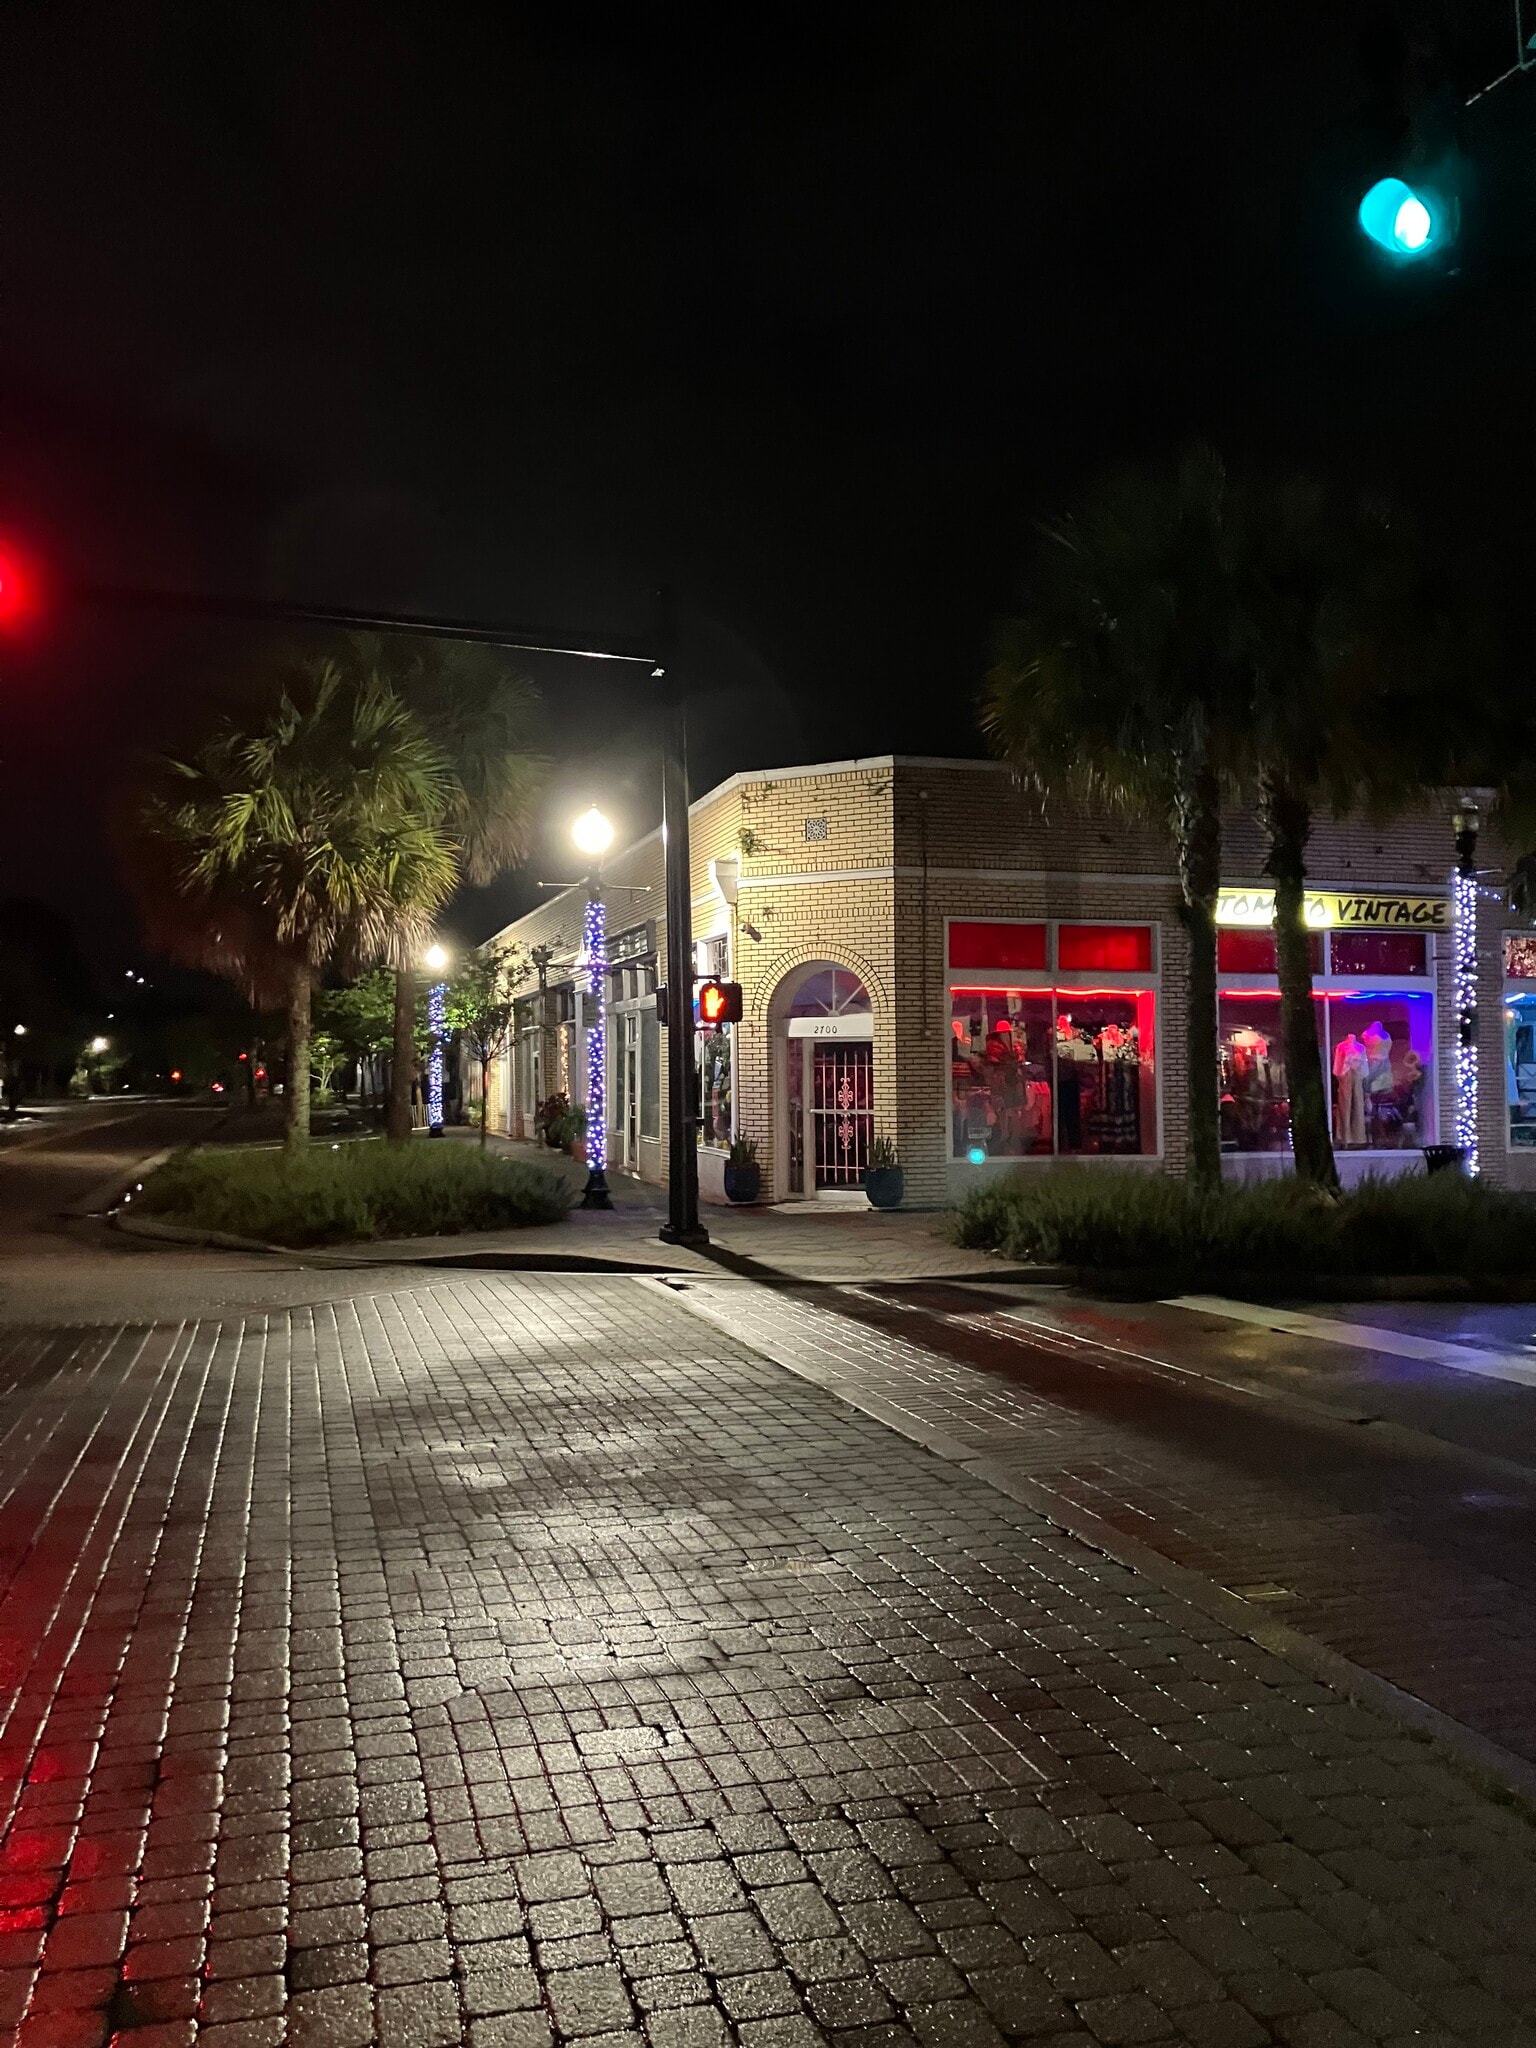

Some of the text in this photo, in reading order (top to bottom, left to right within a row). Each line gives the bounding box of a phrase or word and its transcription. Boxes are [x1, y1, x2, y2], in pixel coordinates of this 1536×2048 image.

[1217, 894, 1446, 923] TOMO VINTAGE
[814, 1025, 838, 1034] 2700
